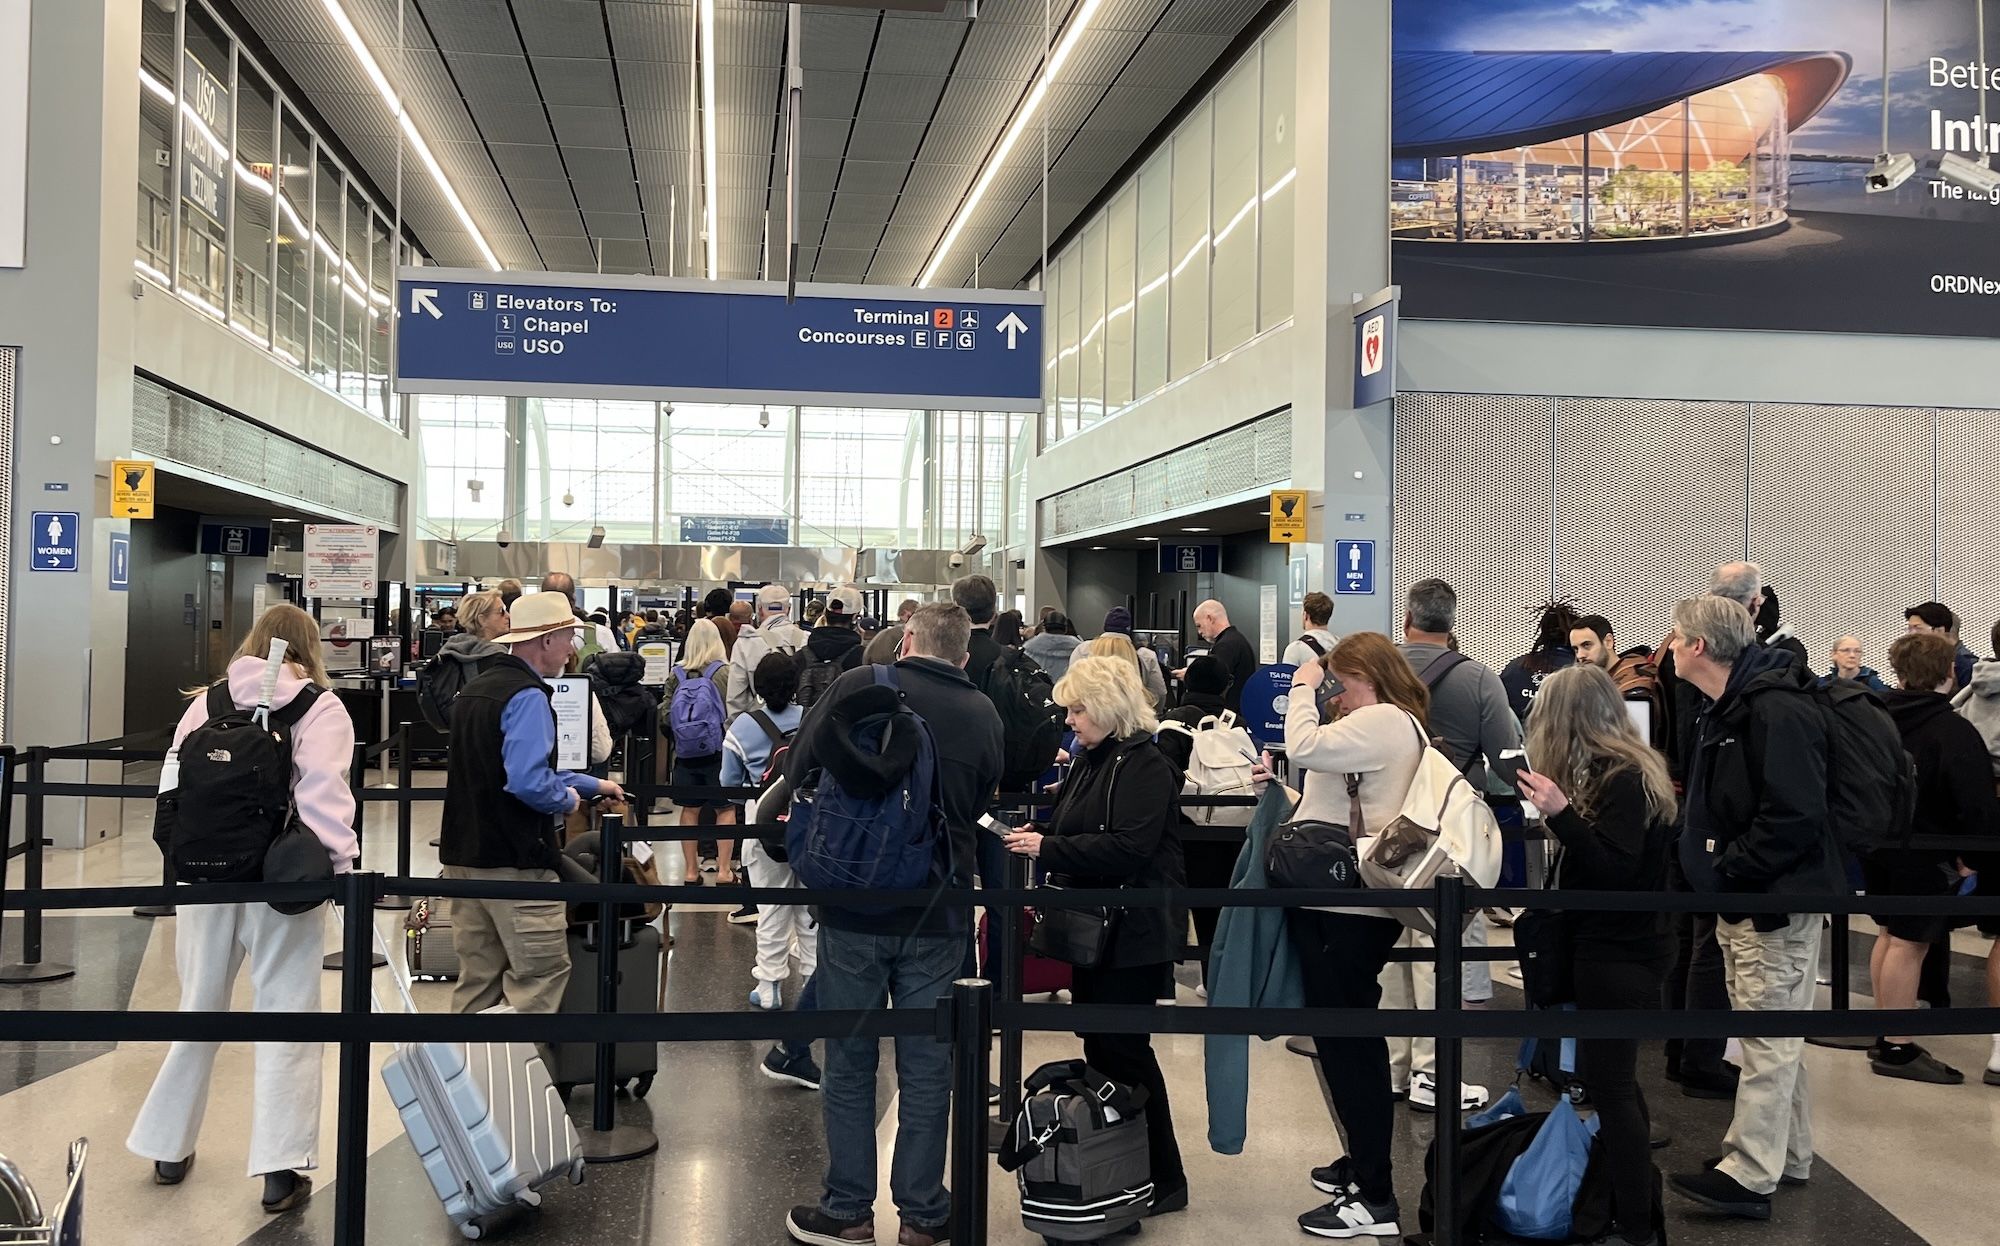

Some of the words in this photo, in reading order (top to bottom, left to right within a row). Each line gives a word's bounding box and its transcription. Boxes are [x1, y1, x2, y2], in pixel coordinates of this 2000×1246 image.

[1930, 57, 2000, 91] Bette
[197, 72, 215, 126] USO
[1931, 109, 2000, 153] Intr
[1929, 180, 1963, 199] The
[1930, 274, 2000, 295] ORDNex
[496, 294, 584, 312] Elevators
[590, 298, 617, 313] To:
[523, 317, 589, 336] Chapel
[853, 308, 929, 326] Terminal
[938, 312, 948, 325] 2
[1367, 320, 1380, 335] AED
[497, 341, 514, 349] USO
[523, 338, 564, 354] USO
[798, 328, 906, 346] Concourses
[915, 332, 926, 346] E
[938, 333, 949, 347] F
[958, 333, 972, 348] G
[37, 547, 72, 555] WOMEN
[1346, 572, 1364, 580] MEN
[557, 684, 570, 693] ID
